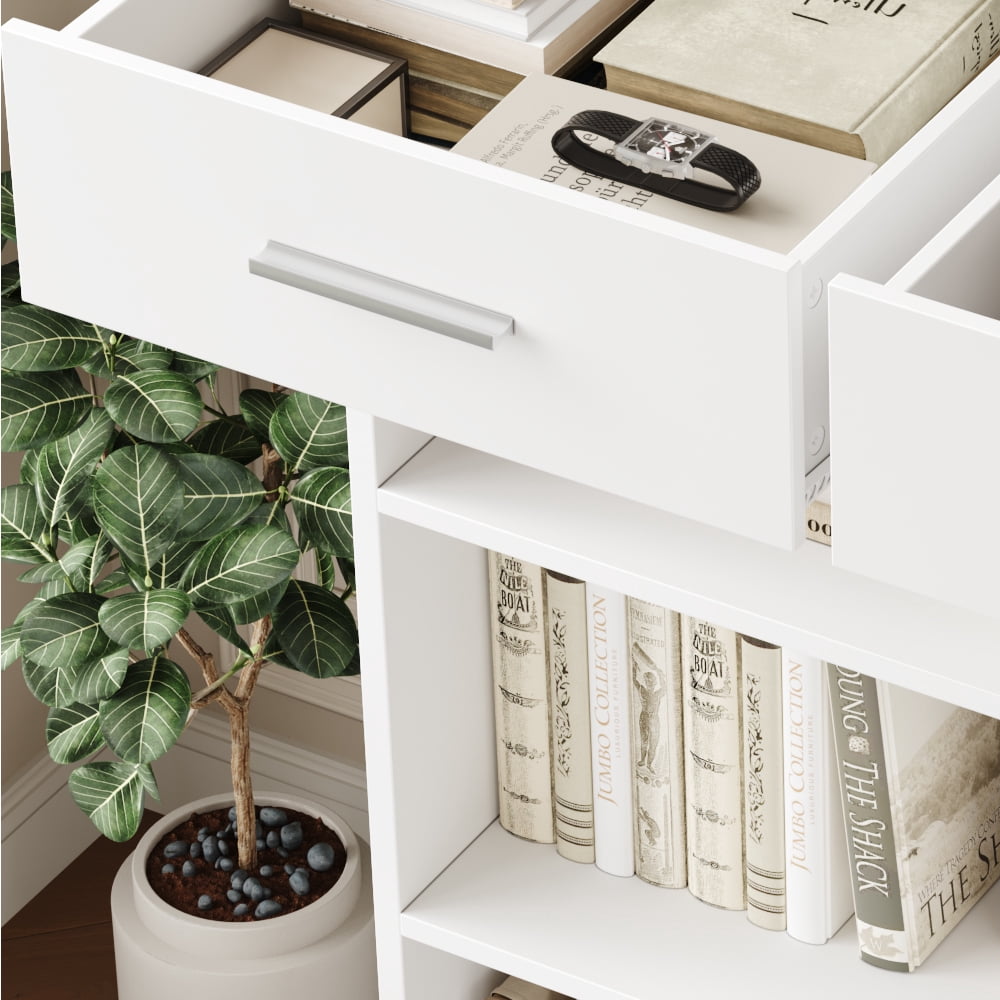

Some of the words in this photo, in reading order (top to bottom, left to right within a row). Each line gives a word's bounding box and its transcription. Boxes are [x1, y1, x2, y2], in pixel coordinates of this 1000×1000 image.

[504, 557, 523, 574] THE
[501, 589, 531, 613] BOAT
[698, 621, 717, 638] THE
[592, 594, 611, 726] COLLECTION
[693, 653, 725, 680] BOAT
[786, 658, 806, 796] COLLECTION
[596, 734, 618, 807] JUMBO
[842, 760, 879, 813] THE
[790, 804, 812, 874] JUMBO
[847, 810, 889, 898] SHACK
[920, 864, 971, 938] THE
